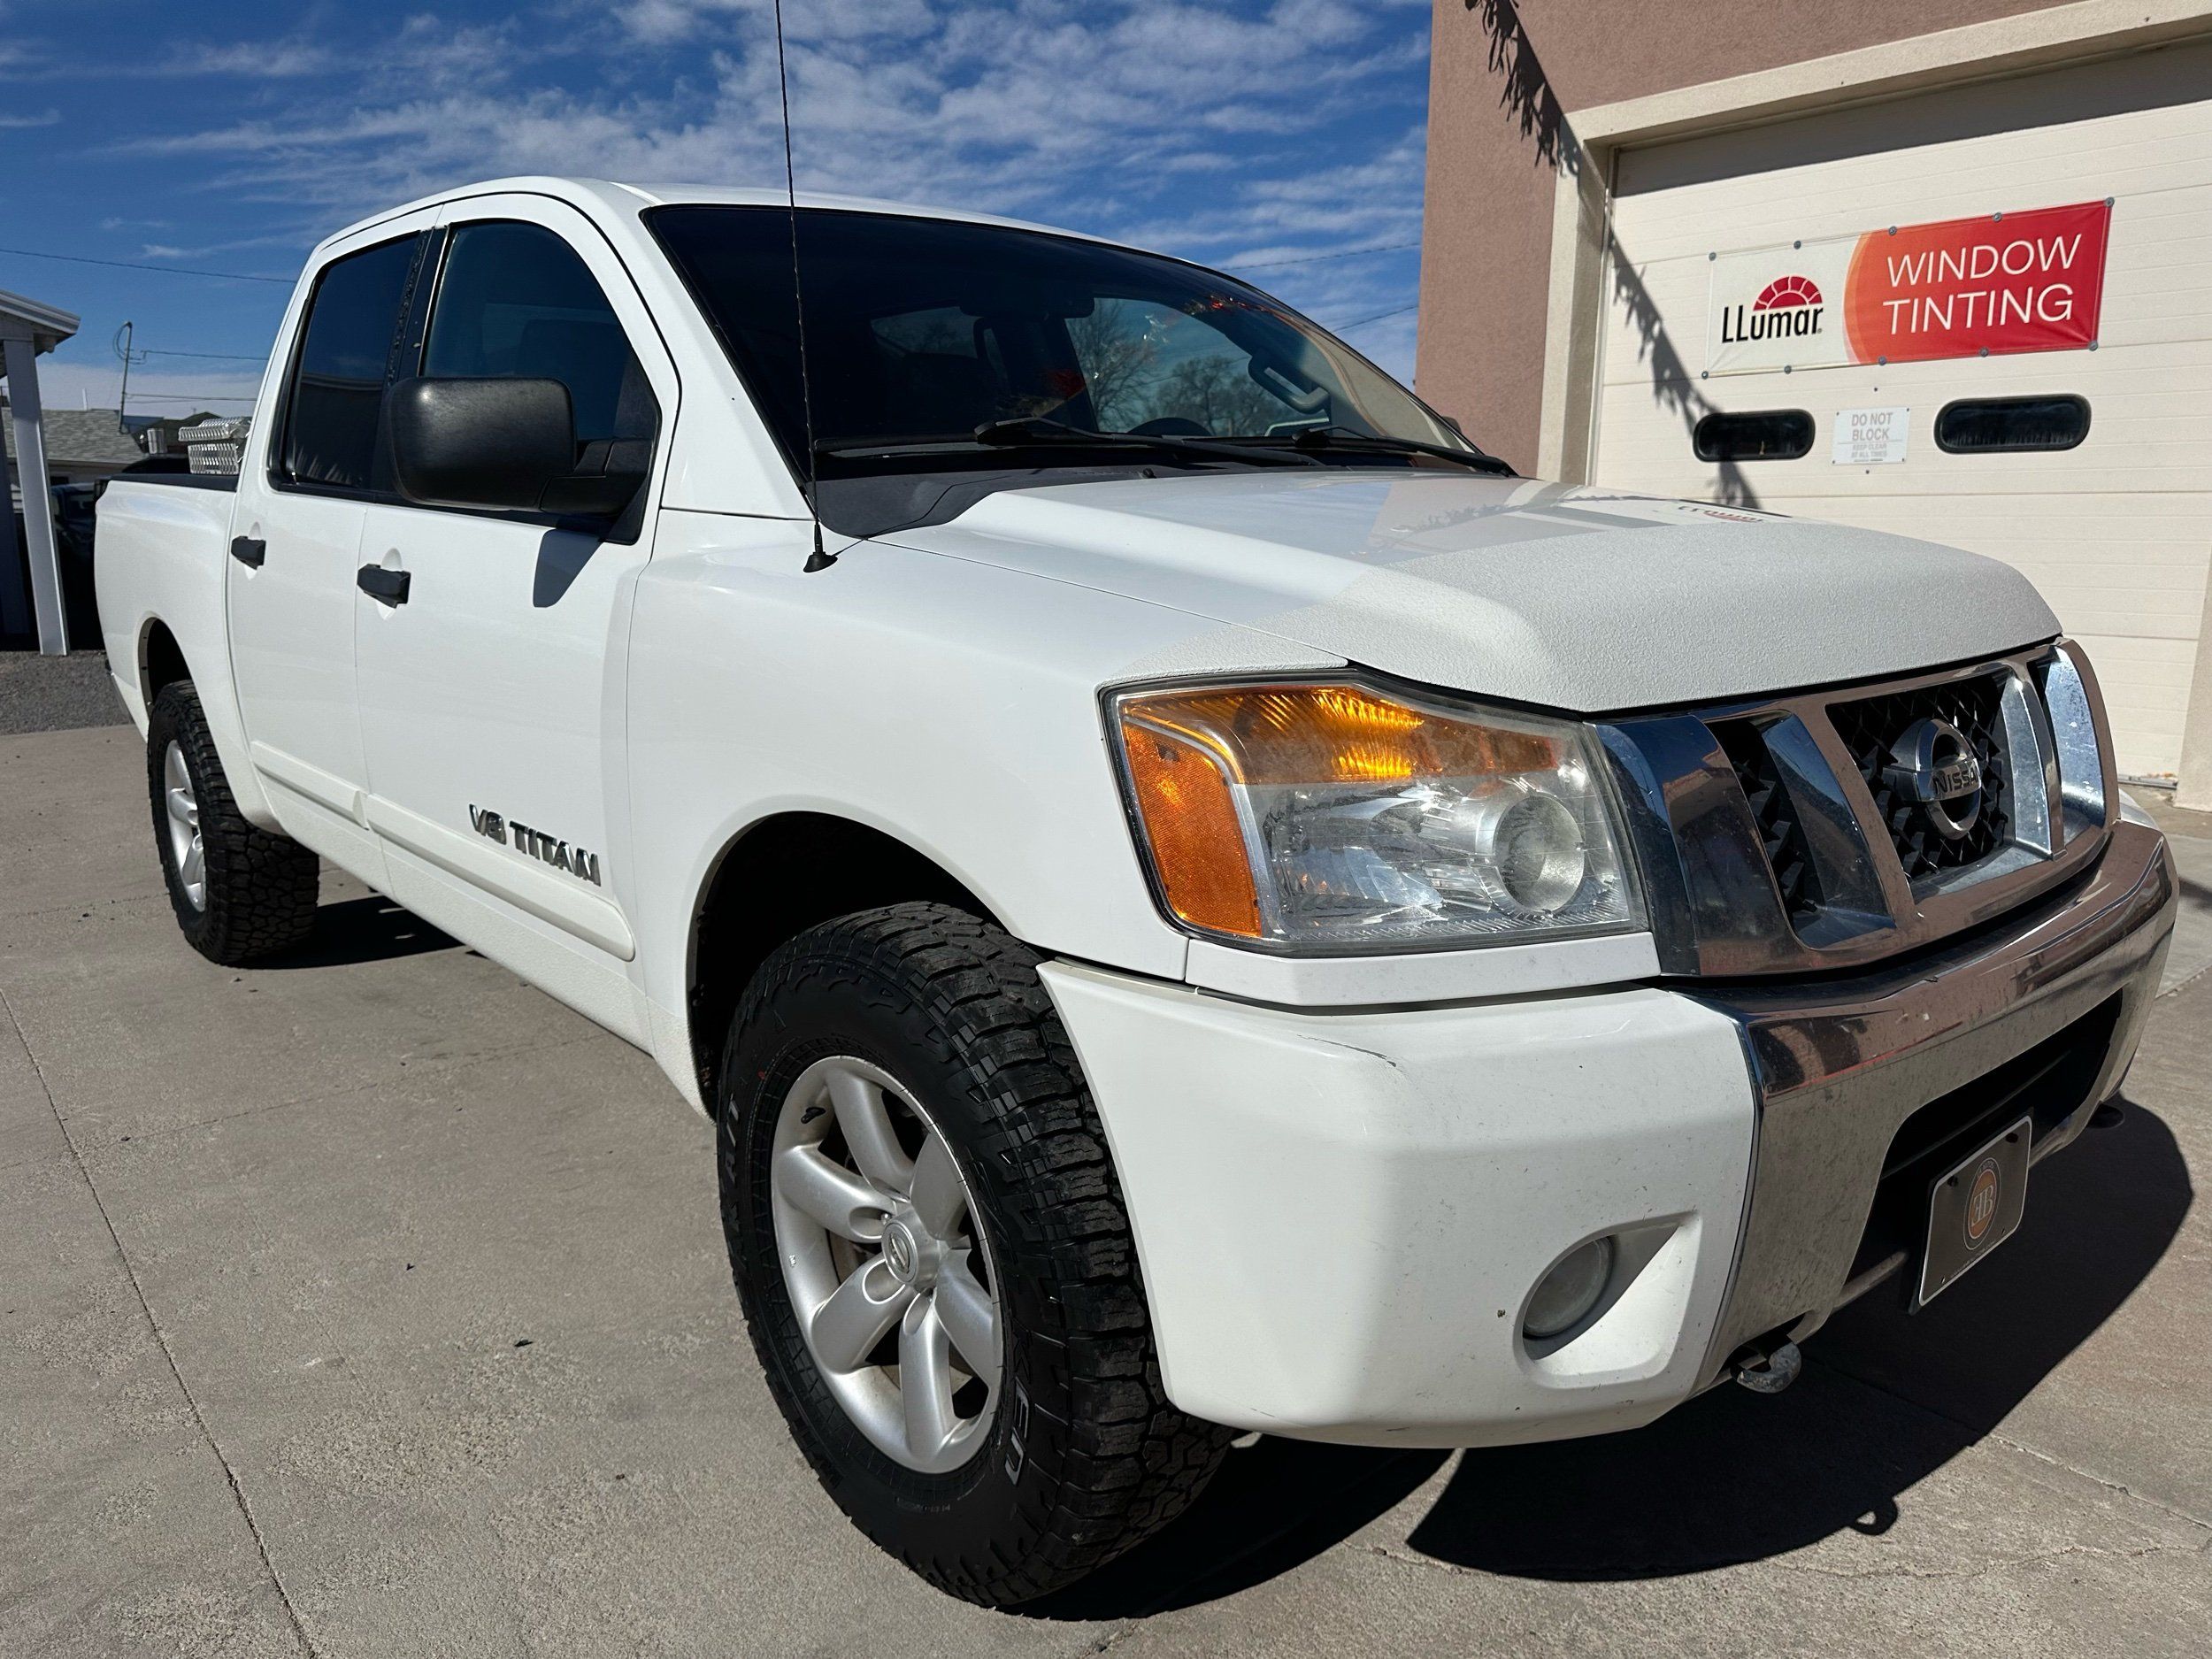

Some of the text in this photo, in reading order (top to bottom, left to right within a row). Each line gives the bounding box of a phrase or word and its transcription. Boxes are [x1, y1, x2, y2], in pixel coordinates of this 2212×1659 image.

[1887, 234, 2082, 288] WINDOW
[1722, 305, 1824, 343] LLumar
[1883, 283, 2073, 335] TINTING
[1851, 412, 1893, 426] DO NOT
[1852, 428, 1890, 442] BLOCK
[1932, 762, 1980, 795] NISSA
[469, 803, 602, 887] V8 TITAN
